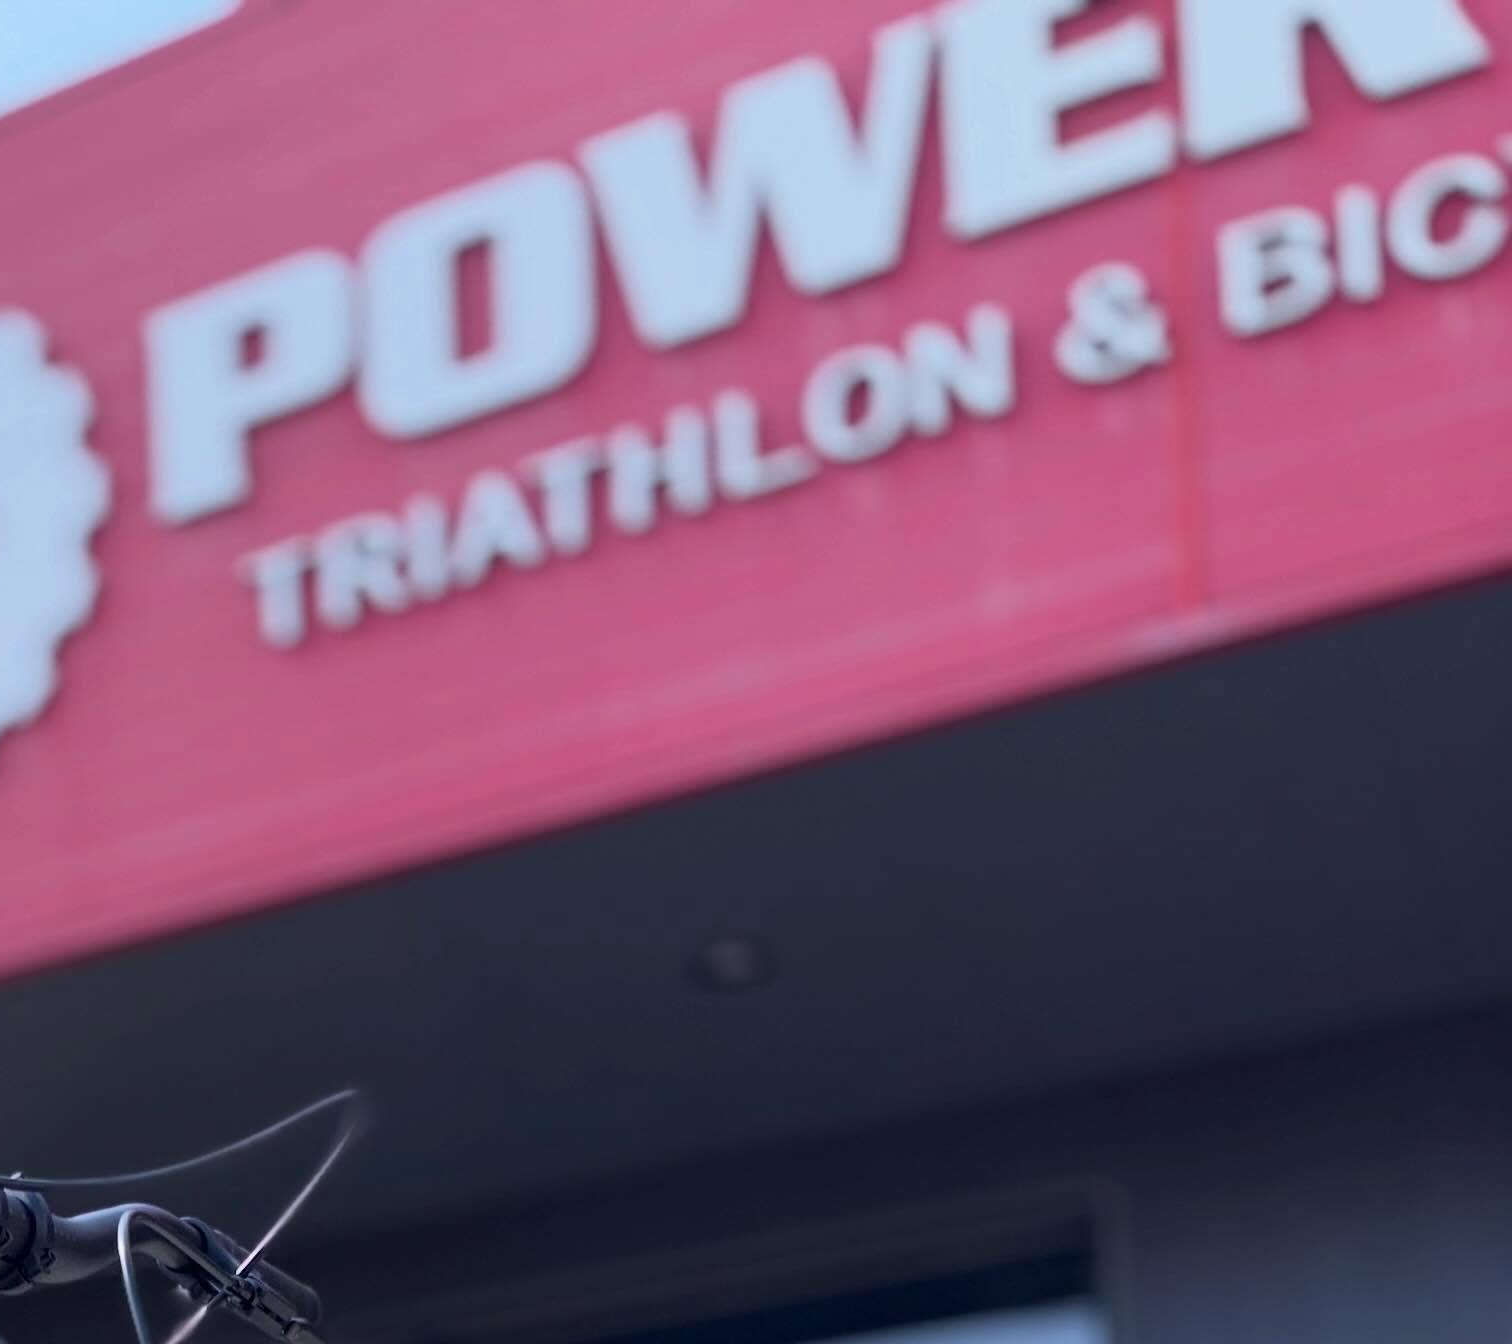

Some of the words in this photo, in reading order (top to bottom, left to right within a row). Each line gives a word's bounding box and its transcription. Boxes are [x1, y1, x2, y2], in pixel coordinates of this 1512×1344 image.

[143, 0, 1491, 524] POWER
[238, 301, 1015, 648] TRIATHLON
[1054, 261, 1171, 387] &
[1215, 132, 1512, 338] BIC
